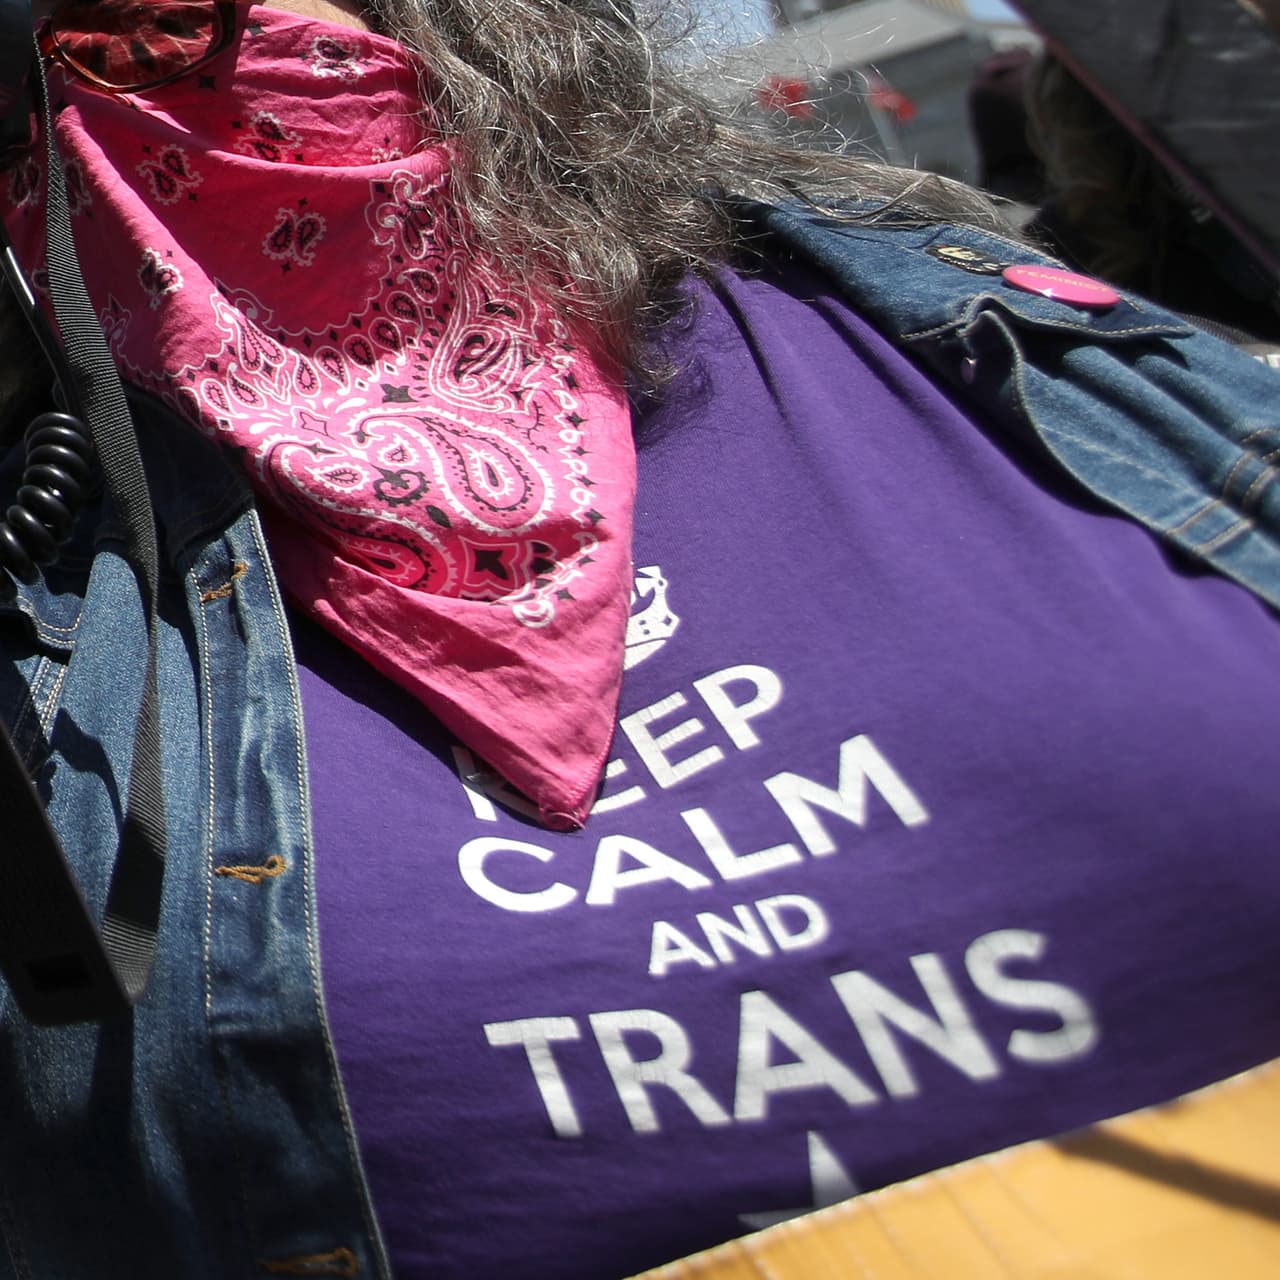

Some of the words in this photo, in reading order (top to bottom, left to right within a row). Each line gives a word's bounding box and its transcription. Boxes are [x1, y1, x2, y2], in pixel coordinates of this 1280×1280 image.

[457, 734, 930, 913] CALM
[649, 893, 830, 976] AND
[484, 929, 1100, 1138] TRANS
